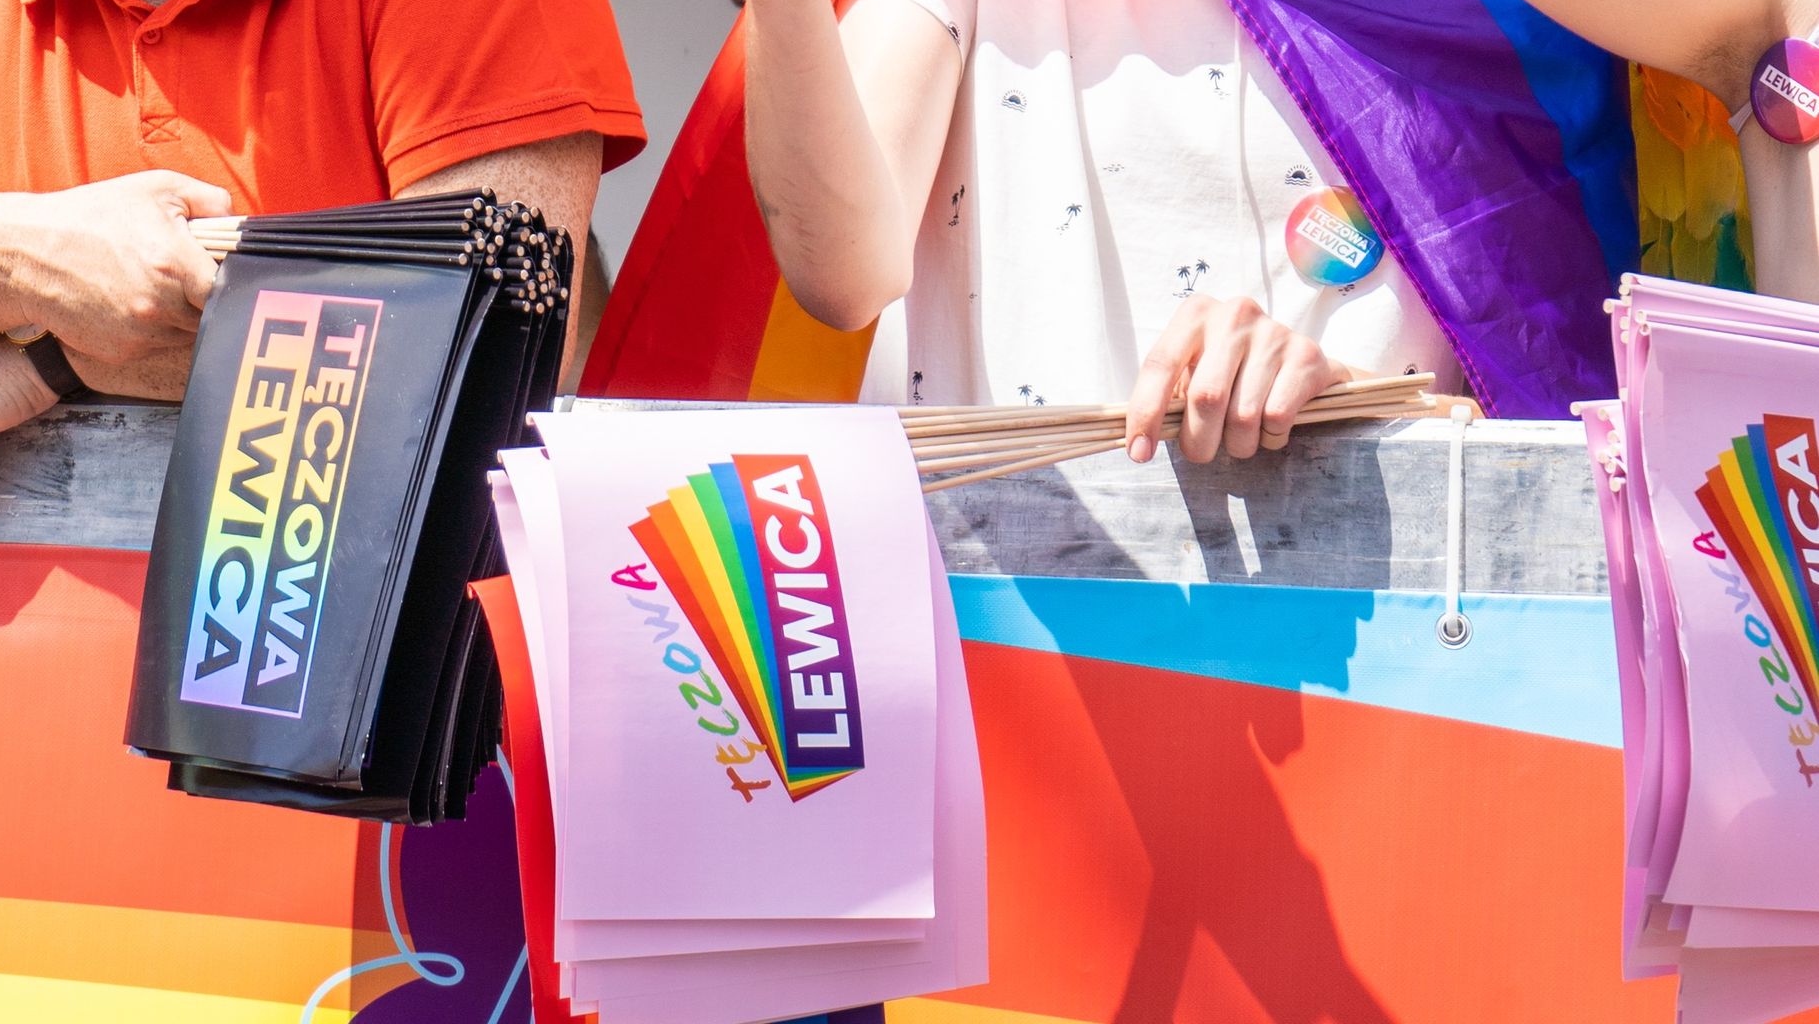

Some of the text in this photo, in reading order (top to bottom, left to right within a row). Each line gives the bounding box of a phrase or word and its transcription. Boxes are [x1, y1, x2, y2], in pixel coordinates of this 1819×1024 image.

[1764, 69, 1818, 112] LEWICA
[1302, 222, 1359, 263] LEWICA
[195, 317, 307, 682] LEWICA
[257, 324, 366, 687] TĘCZOWA
[752, 464, 851, 749] LEWICA
